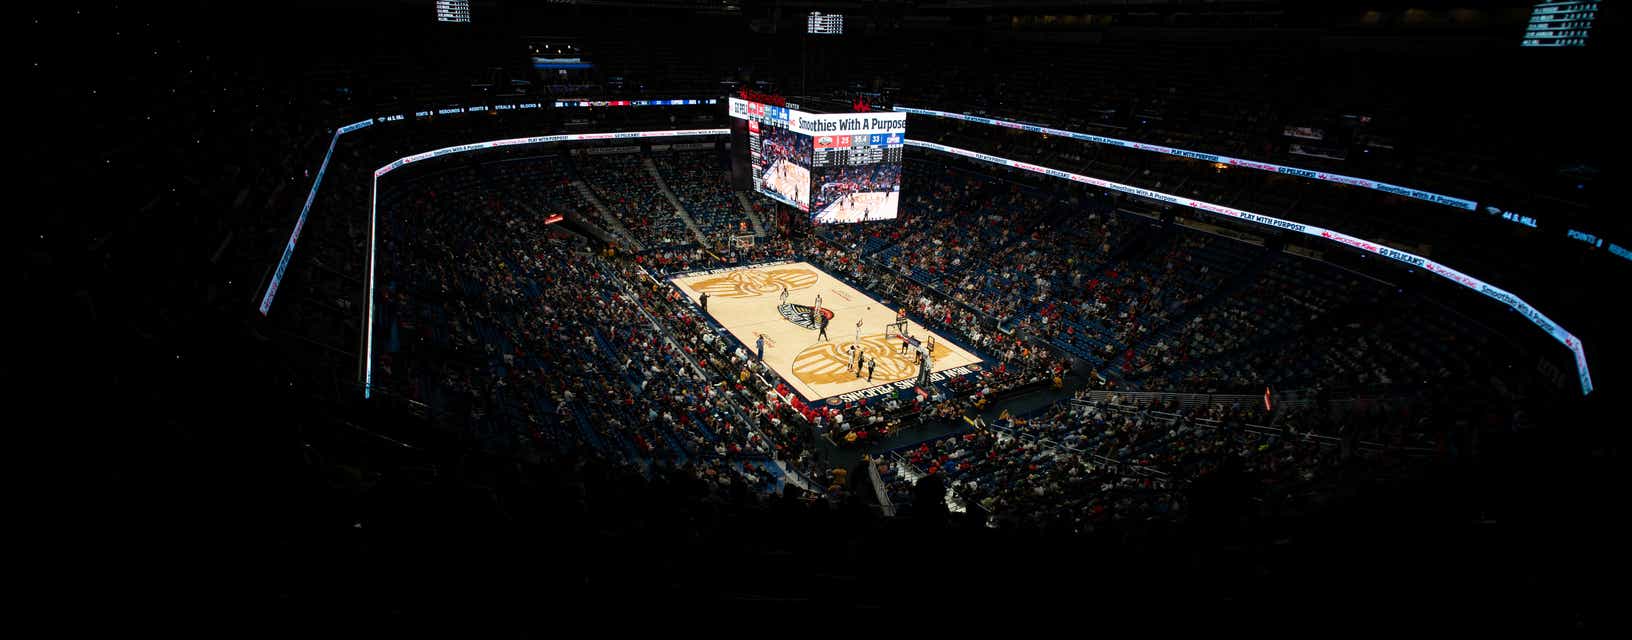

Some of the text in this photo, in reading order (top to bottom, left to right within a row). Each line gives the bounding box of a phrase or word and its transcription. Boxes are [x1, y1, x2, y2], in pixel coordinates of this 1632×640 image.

[799, 117, 906, 132] Smoothies With A Purpose
[872, 135, 880, 143] 33
[1239, 212, 1254, 220] PLAY
[1255, 215, 1272, 224] WITH
[1379, 247, 1425, 266] GO PELICANS!
[943, 365, 971, 379] NEW
[840, 383, 895, 402] PELICANS
